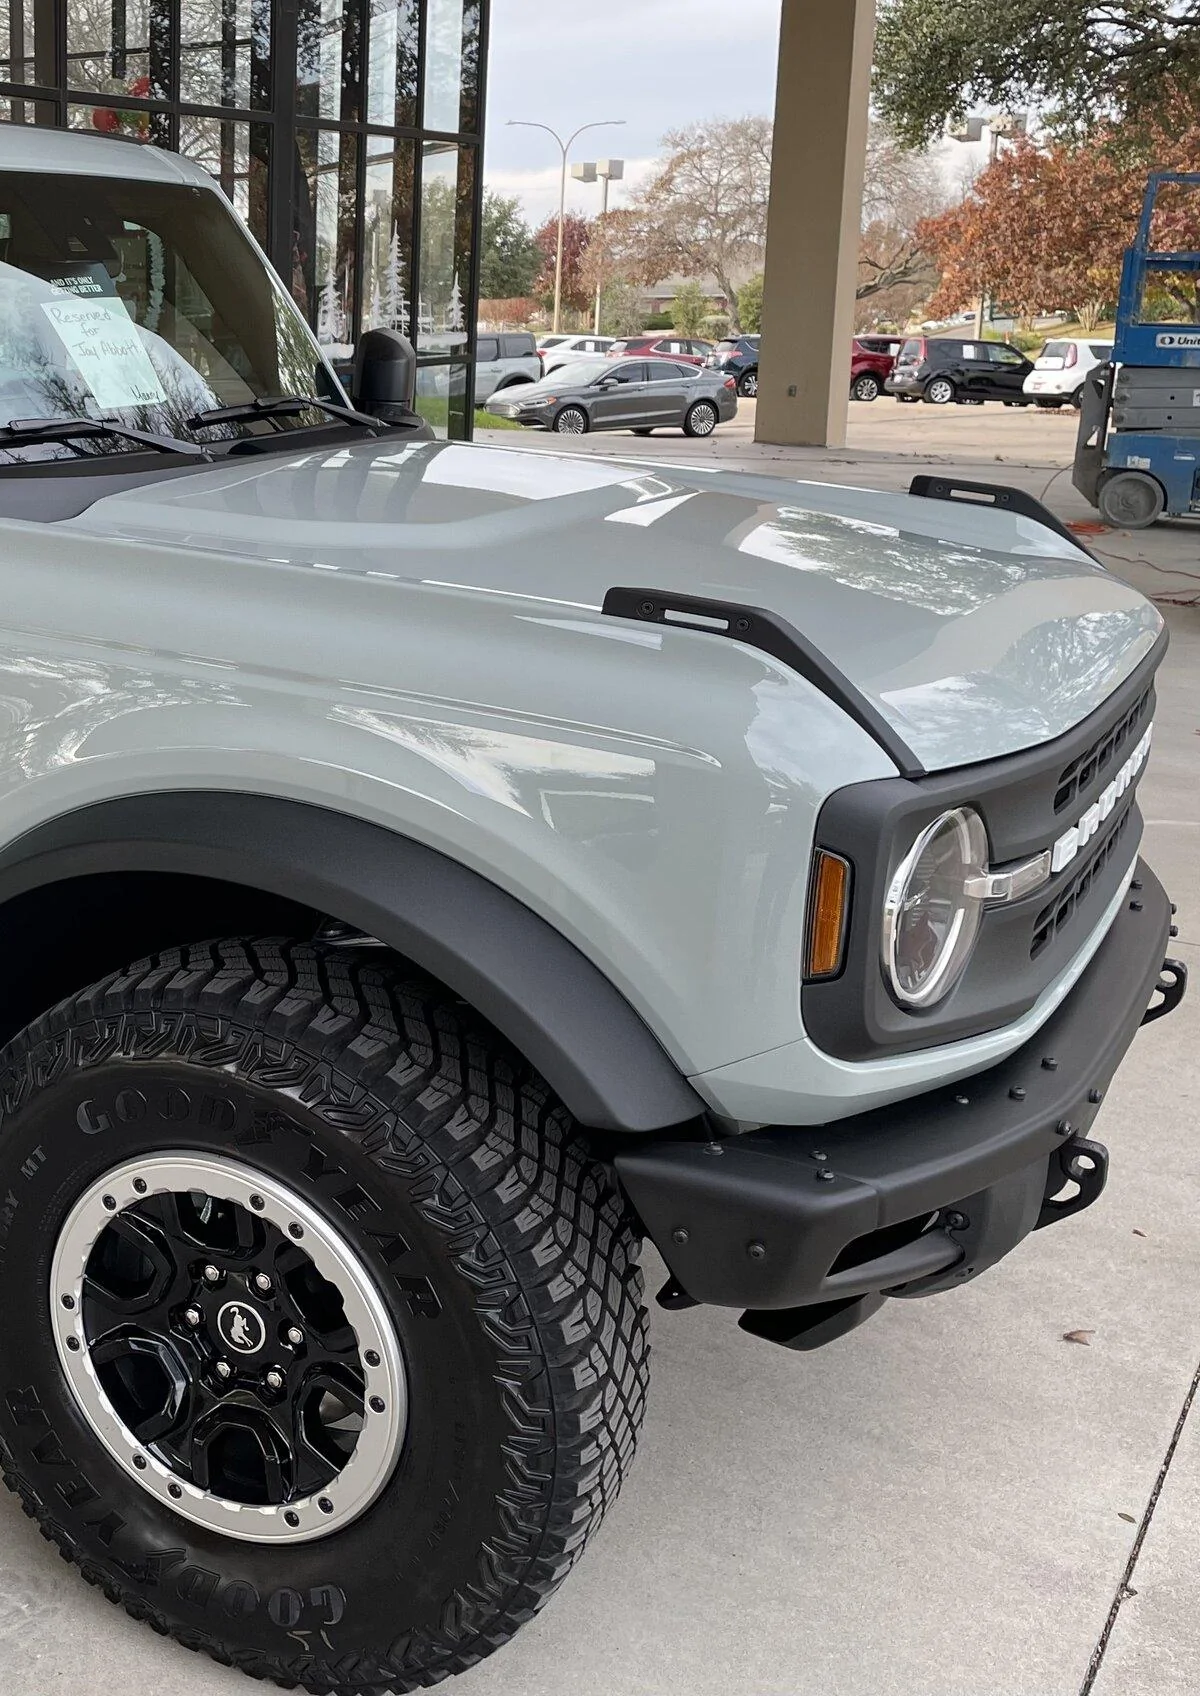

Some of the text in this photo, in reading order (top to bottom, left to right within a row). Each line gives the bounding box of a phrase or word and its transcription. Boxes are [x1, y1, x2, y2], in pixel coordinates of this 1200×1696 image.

[77, 275, 94, 285] ONLY
[78, 283, 104, 294] BETTER
[50, 307, 113, 324] Reserved
[80, 322, 100, 337] for
[1051, 721, 1154, 873] BRONCO
